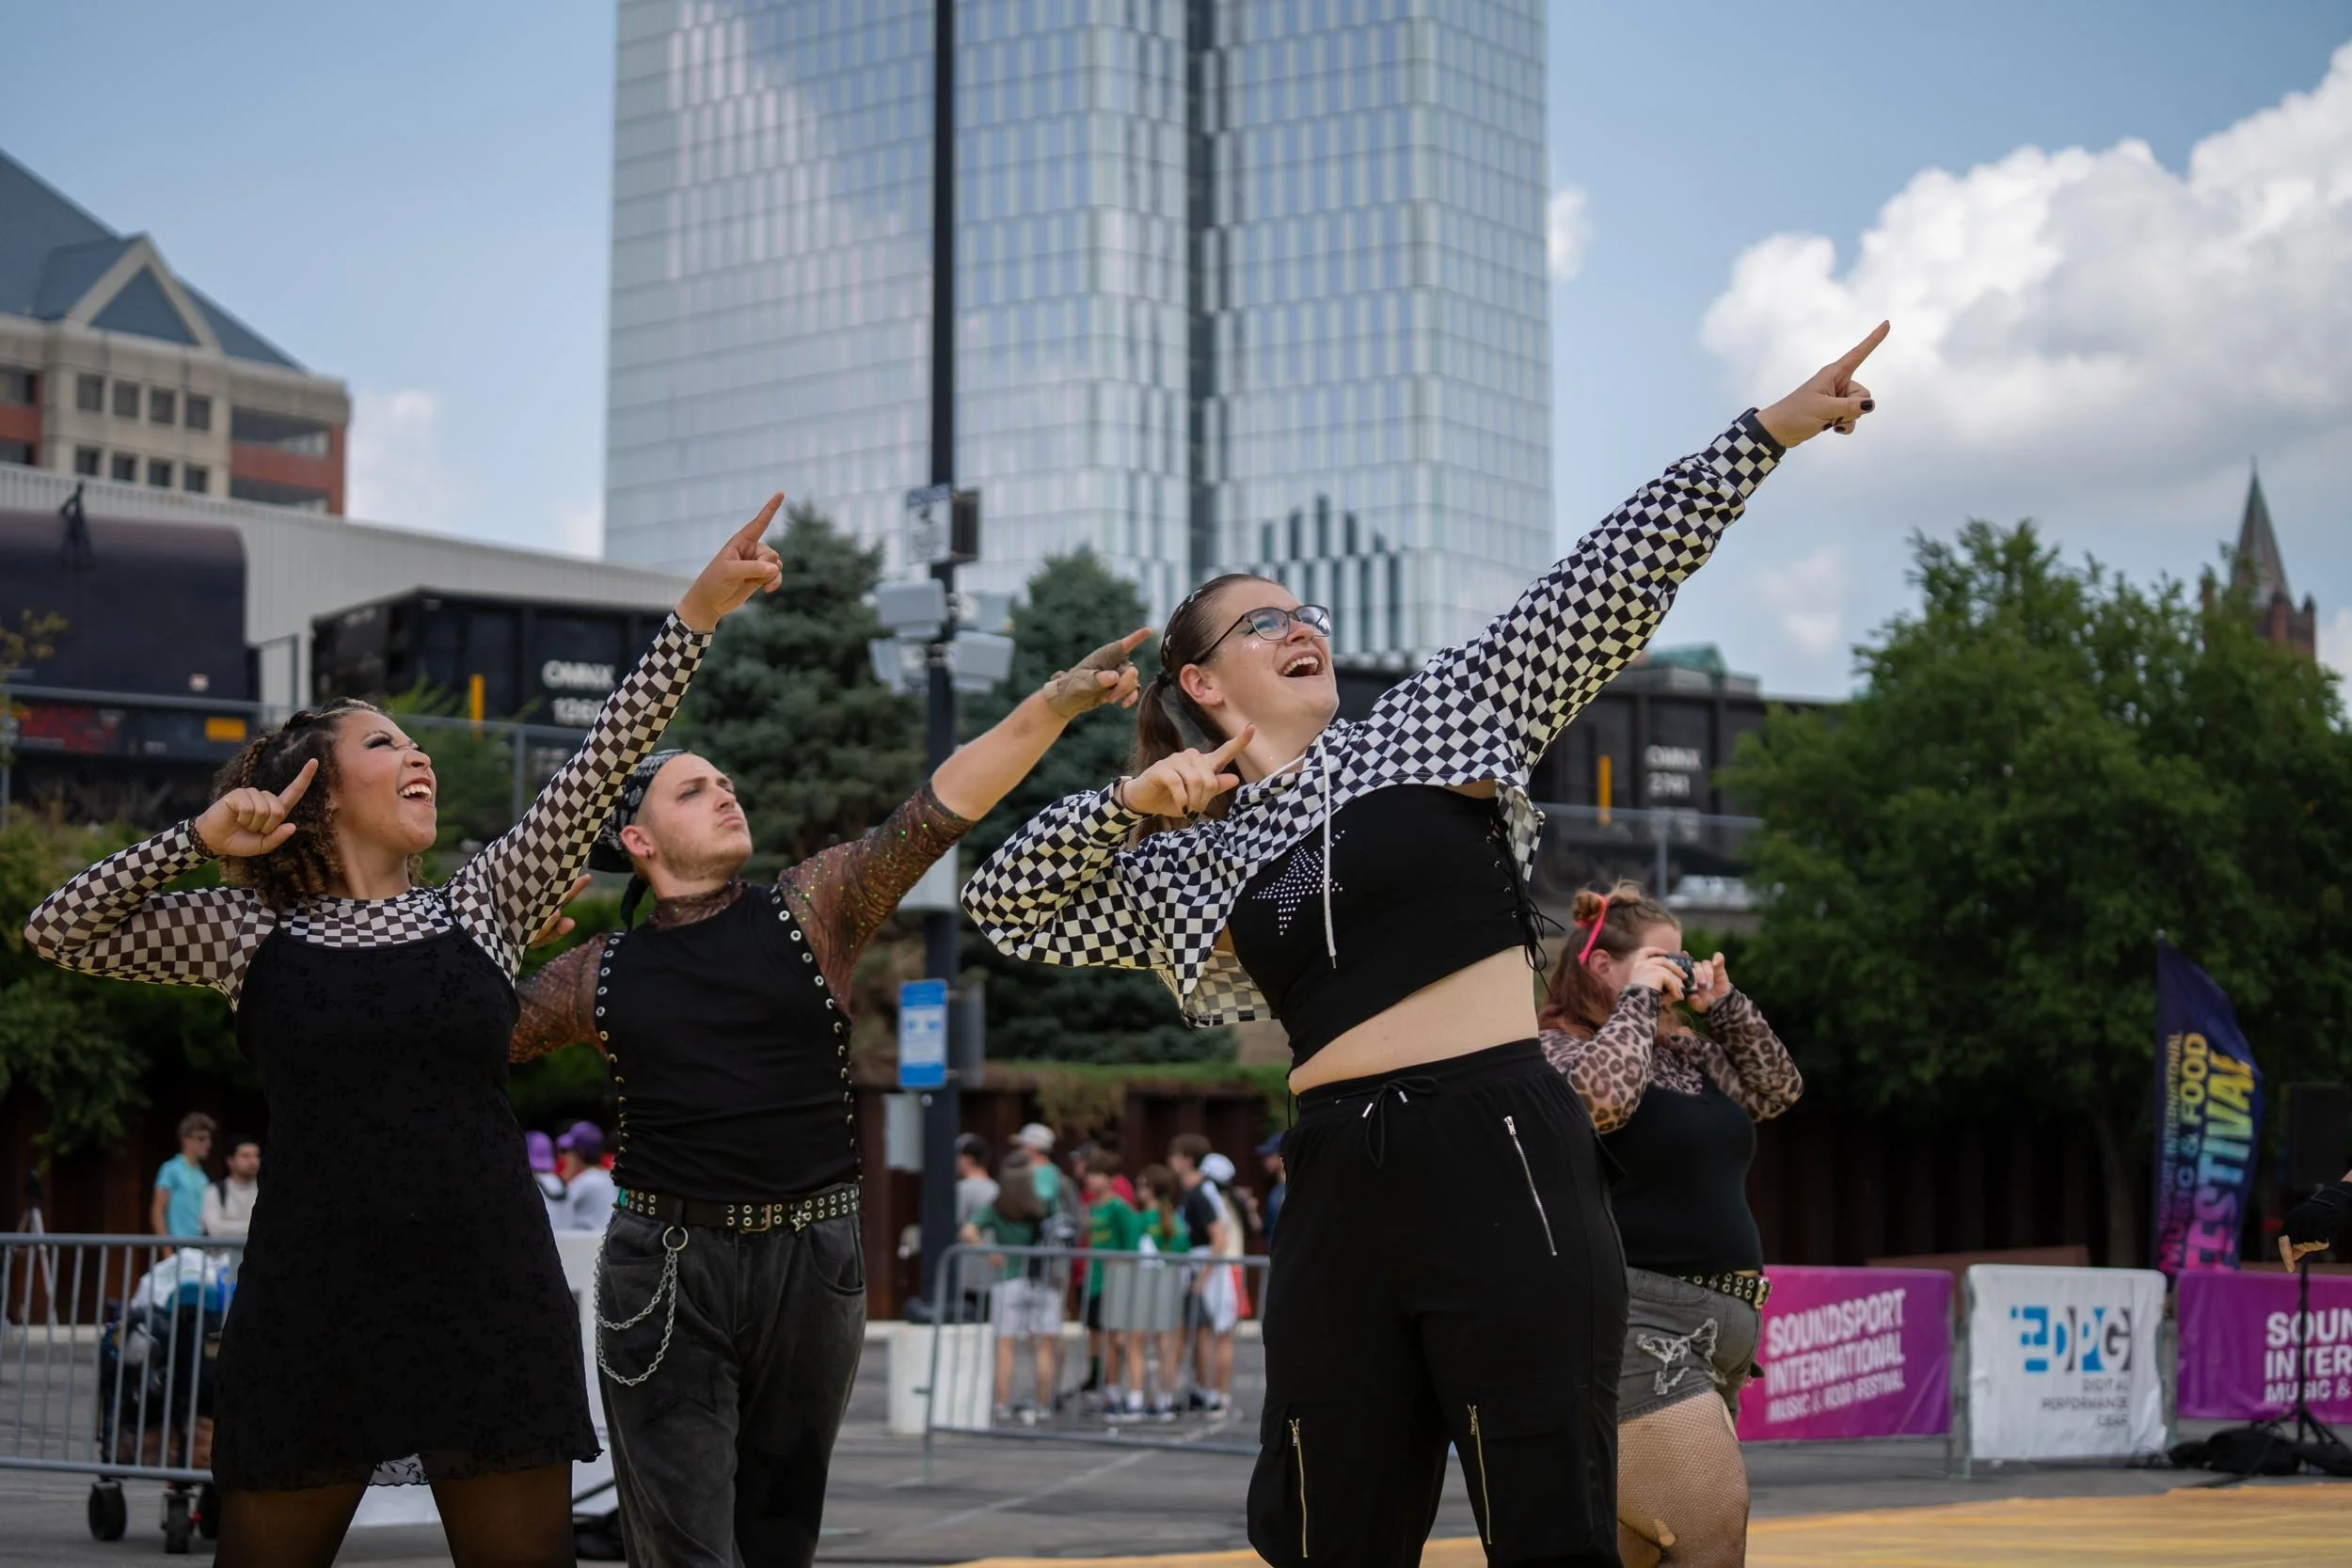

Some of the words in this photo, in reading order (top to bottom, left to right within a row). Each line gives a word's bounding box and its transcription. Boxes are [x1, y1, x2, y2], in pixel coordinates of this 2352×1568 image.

[2180, 1032, 2208, 1126] FOOD
[1766, 1287, 1906, 1359] SOUNDSPORT
[1765, 1330, 1906, 1398] INTERNATIONAL
[2082, 1377, 2128, 1392] DIGITAL
[1766, 1392, 1811, 1425] MUSIC
[1854, 1368, 1906, 1402] FESTIVAL
[2042, 1396, 2129, 1410] PERFORMANCE
